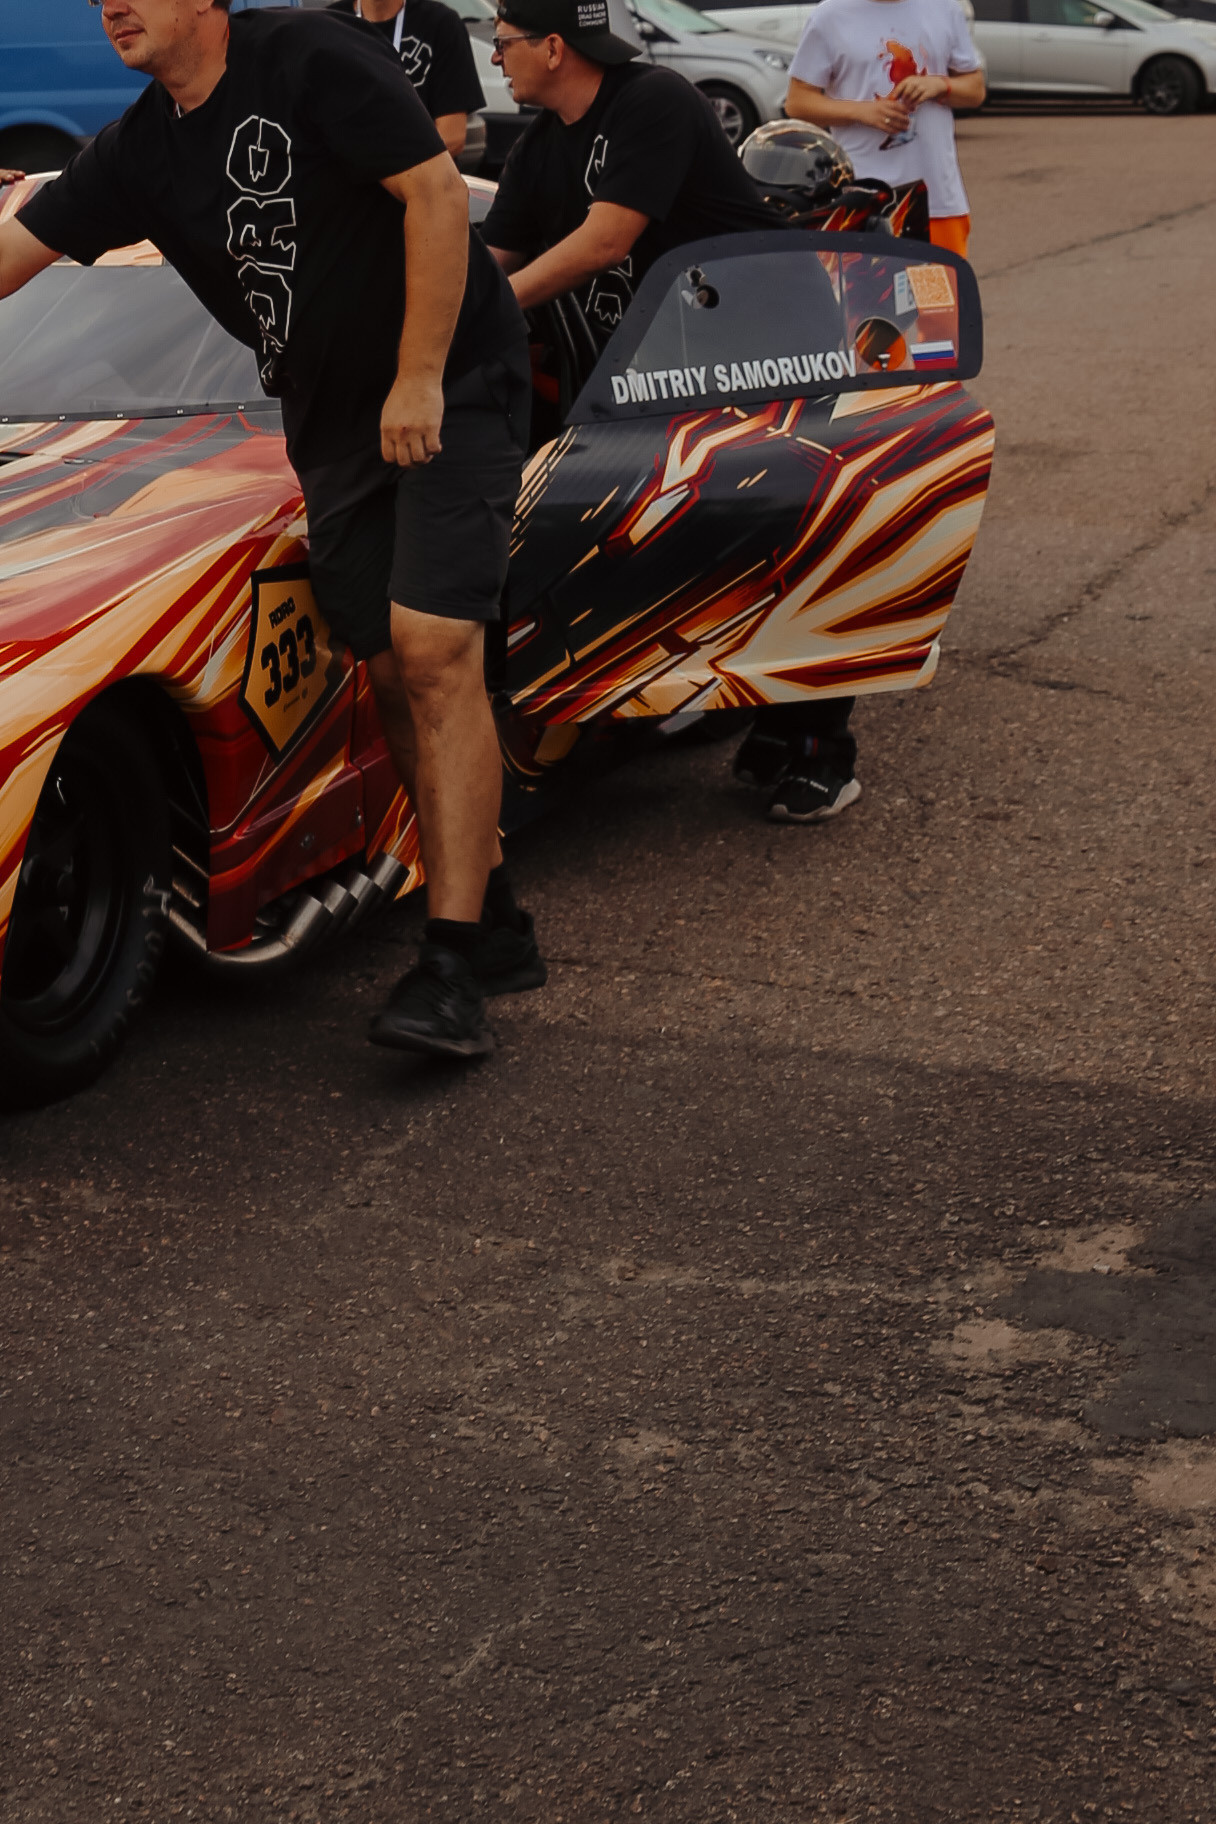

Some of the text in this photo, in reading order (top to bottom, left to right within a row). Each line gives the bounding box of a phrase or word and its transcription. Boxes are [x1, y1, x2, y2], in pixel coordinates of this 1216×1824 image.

[577, 2, 605, 13] RUSSIAN
[611, 349, 857, 405] DMITRIY SAMORUKOV
[260, 614, 317, 709] 333
